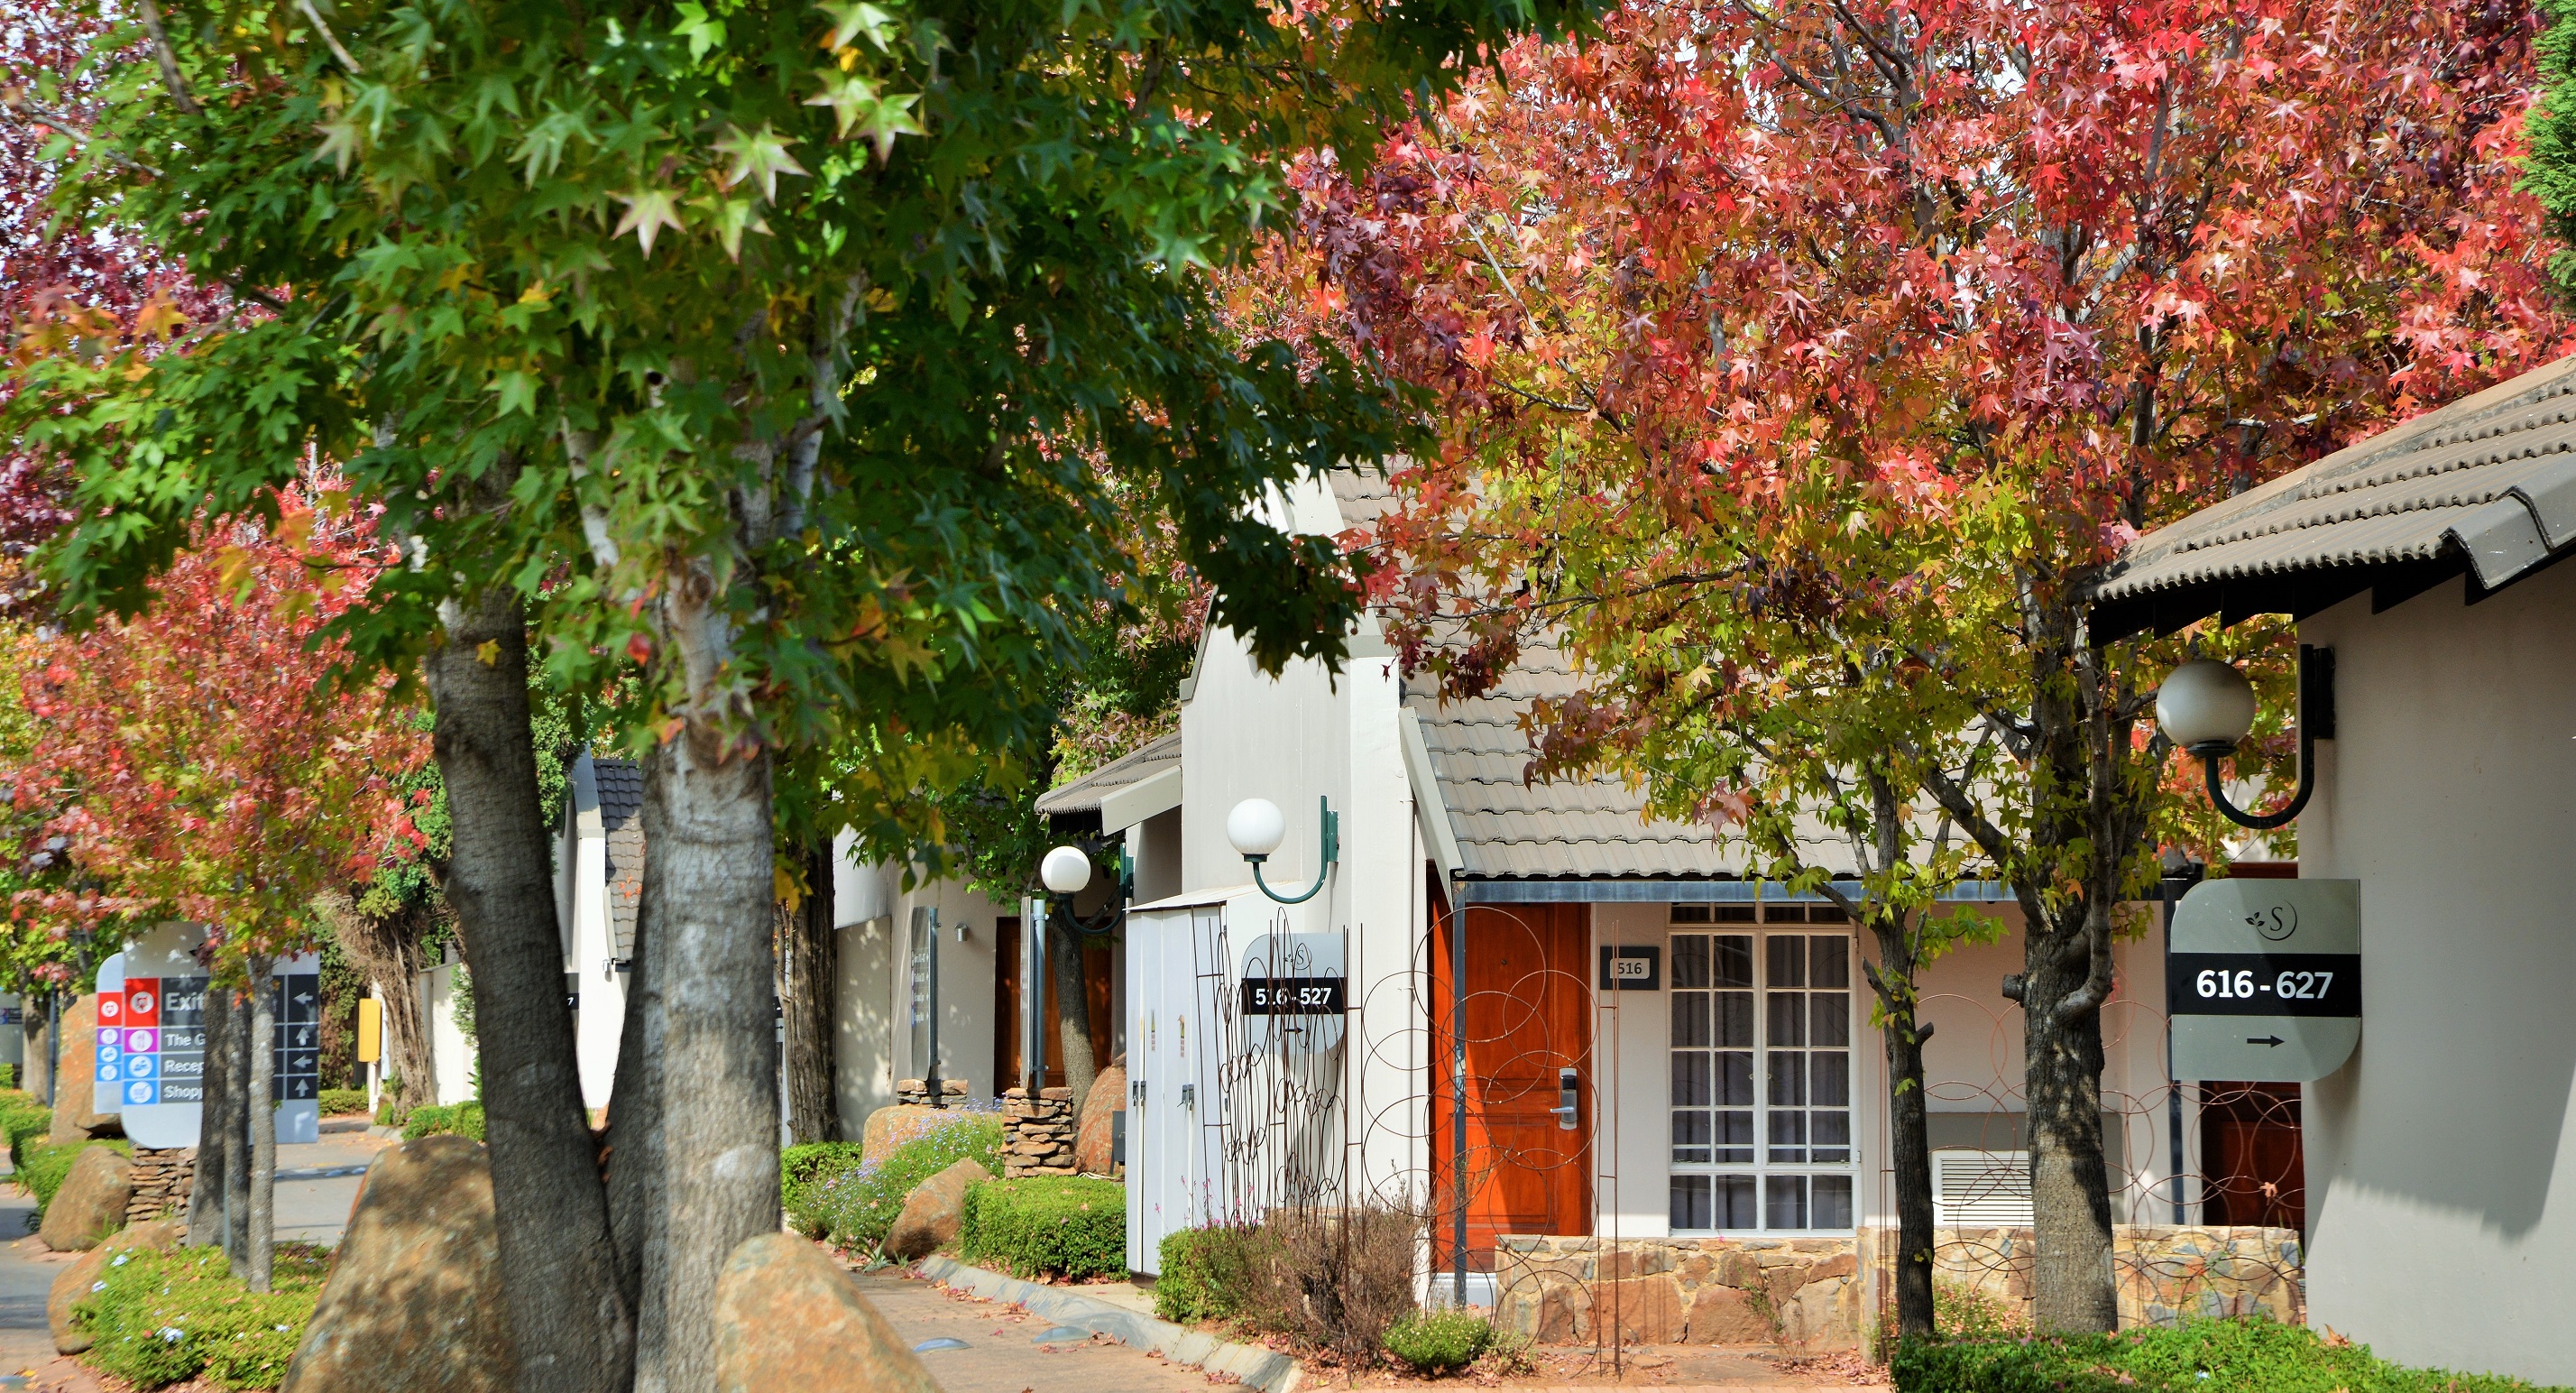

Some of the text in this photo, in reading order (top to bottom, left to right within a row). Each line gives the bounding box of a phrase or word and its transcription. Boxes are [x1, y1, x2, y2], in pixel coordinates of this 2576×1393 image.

[2269, 906, 2283, 932] S
[1617, 962, 1642, 974] 516
[164, 992, 205, 1011] Exit
[1255, 986, 1332, 1006] 56-527
[164, 1033, 192, 1047] The
